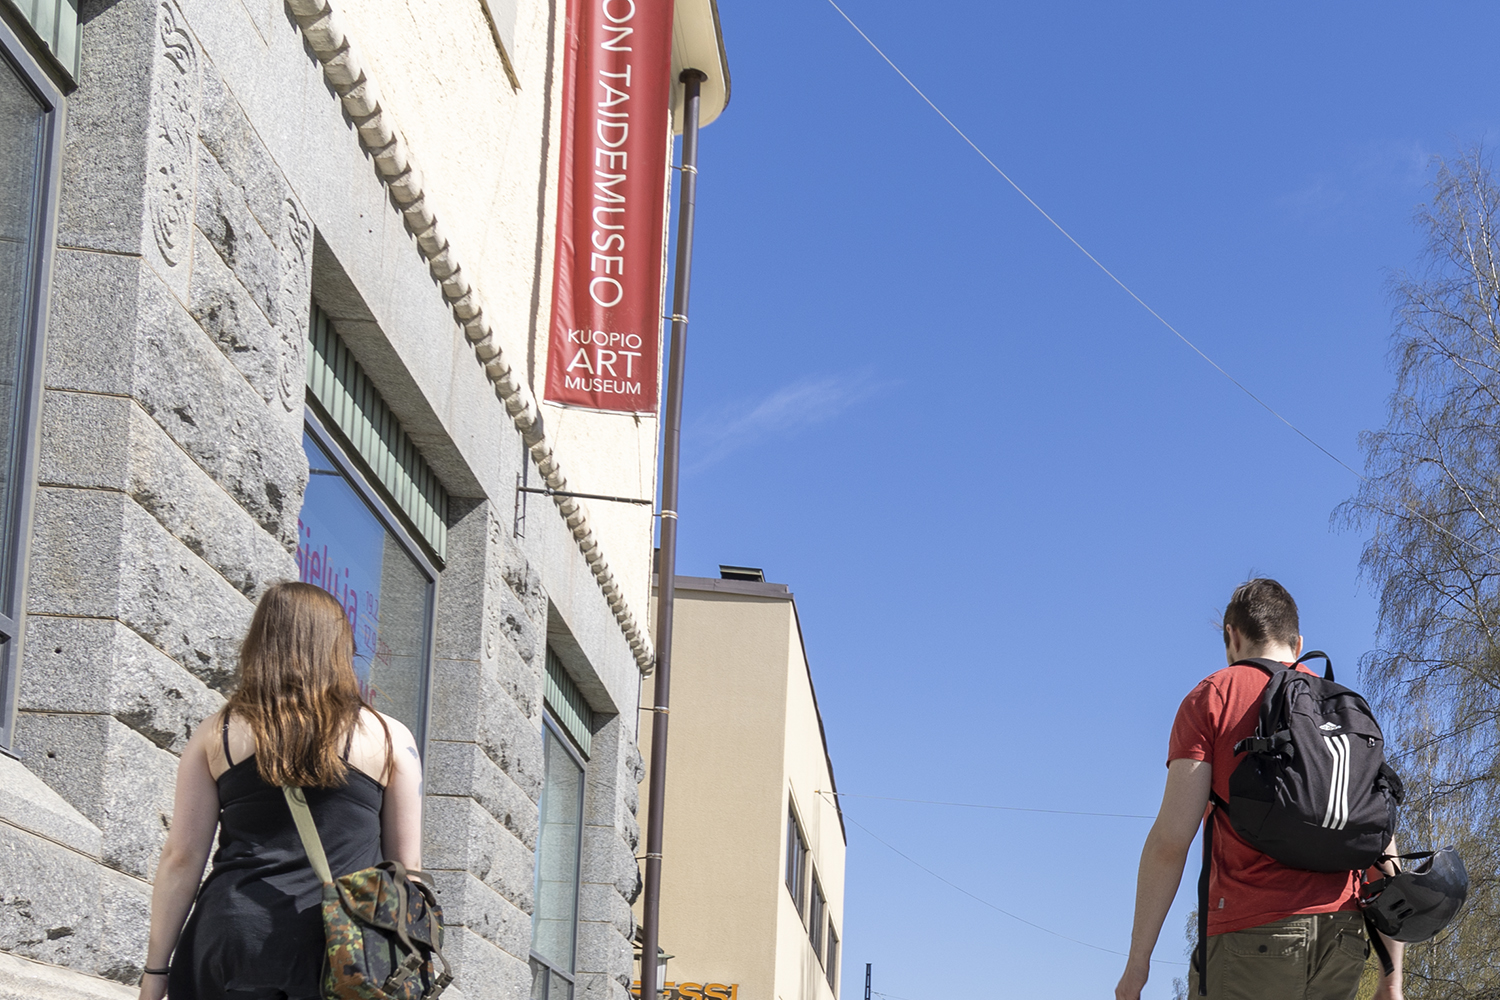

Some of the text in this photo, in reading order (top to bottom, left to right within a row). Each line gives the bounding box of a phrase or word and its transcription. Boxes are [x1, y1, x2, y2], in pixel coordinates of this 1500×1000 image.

[589, 64, 632, 308] TAIDEMUSEO
[567, 329, 642, 348] KUOPIO
[566, 348, 642, 378] ART
[565, 375, 641, 395] MUSEUM
